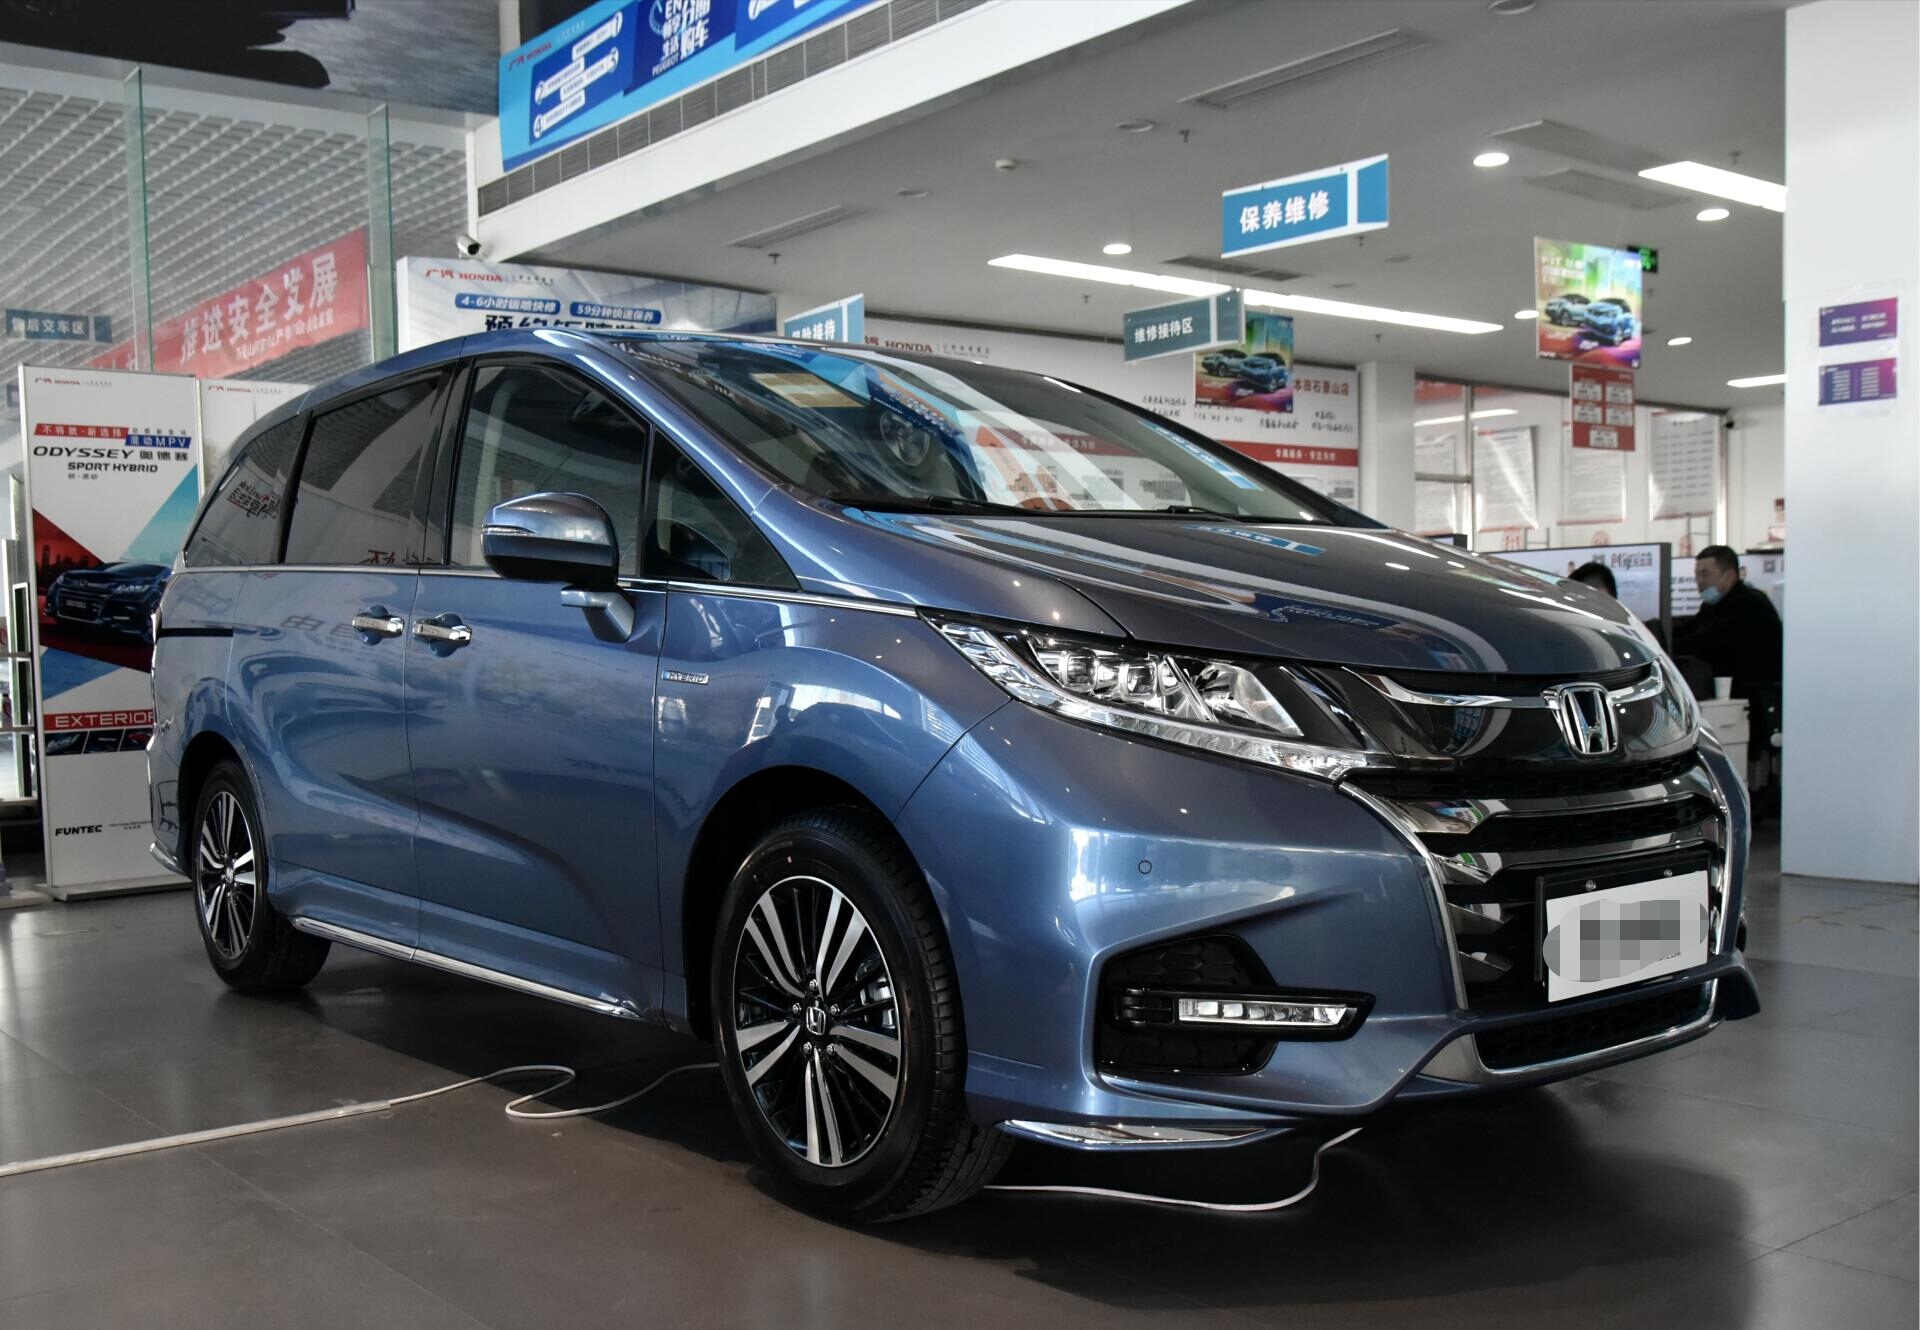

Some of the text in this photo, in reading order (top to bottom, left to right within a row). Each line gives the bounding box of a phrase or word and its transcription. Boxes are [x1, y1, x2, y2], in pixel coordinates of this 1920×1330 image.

[1239, 190, 1330, 235] 保养维修
[459, 272, 503, 283] HONDA
[181, 251, 338, 364] 推进安全发展
[577, 304, 655, 322] 59分钟快速保养
[1133, 316, 1194, 343] 维修接待区
[885, 340, 934, 353] HONDA
[33, 445, 134, 460] ODYSSEY
[67, 462, 159, 474] SPORT HYBRID
[55, 824, 103, 837] FUNTEC
